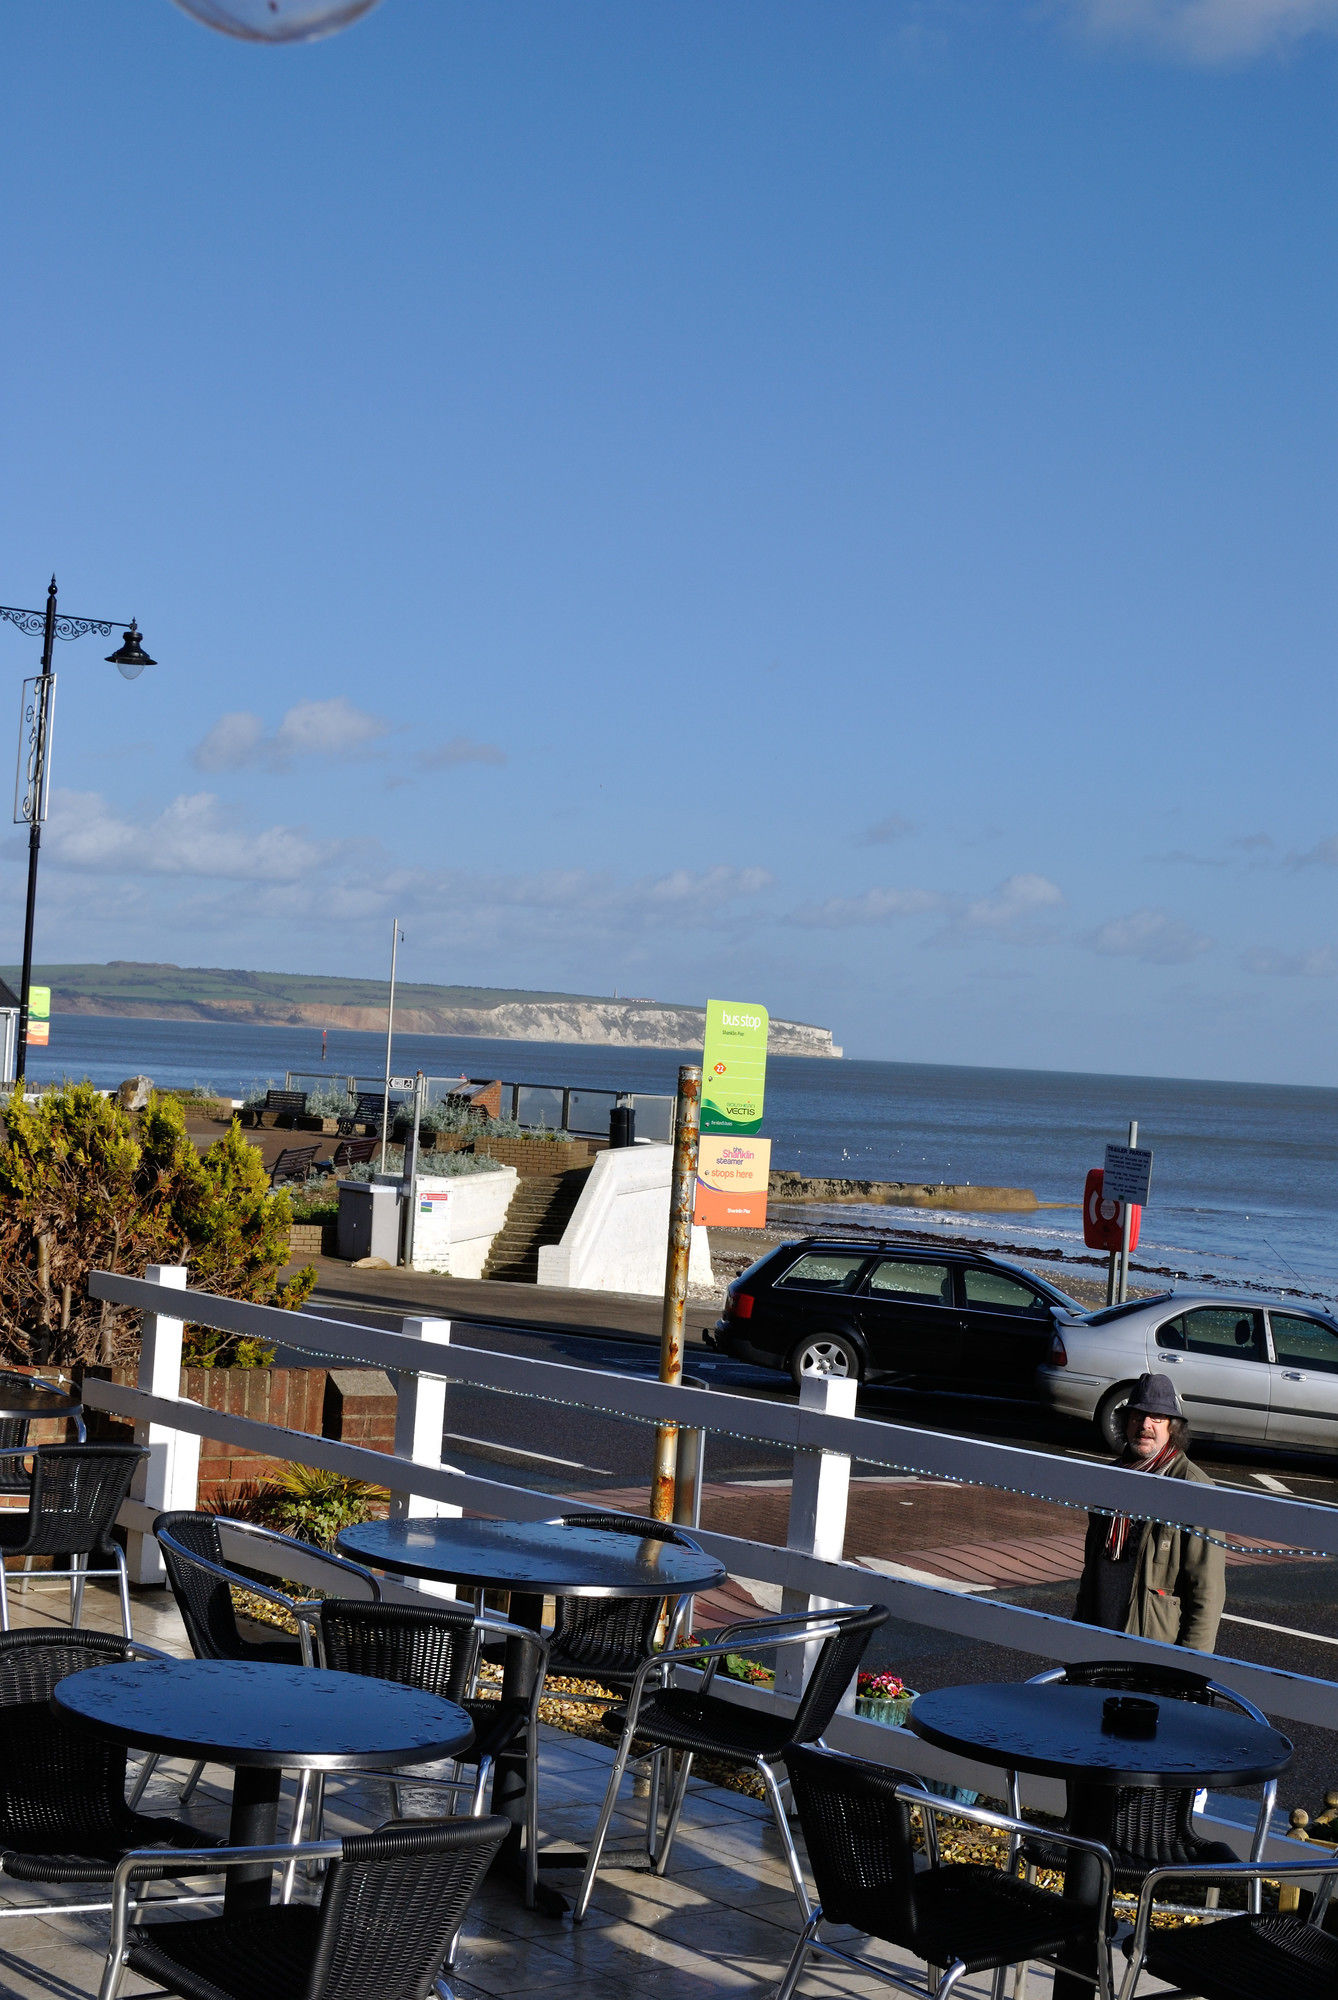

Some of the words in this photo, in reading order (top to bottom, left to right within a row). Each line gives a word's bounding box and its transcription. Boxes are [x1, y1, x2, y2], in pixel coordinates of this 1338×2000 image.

[722, 1010, 740, 1026] bus
[740, 1014, 761, 1031] stop
[716, 1064, 725, 1073] 22
[726, 1107, 755, 1116] VECTIS
[722, 1149, 755, 1160] Shanklin
[716, 1157, 744, 1165] steamer
[711, 1168, 735, 1180] stops
[736, 1169, 753, 1179] here
